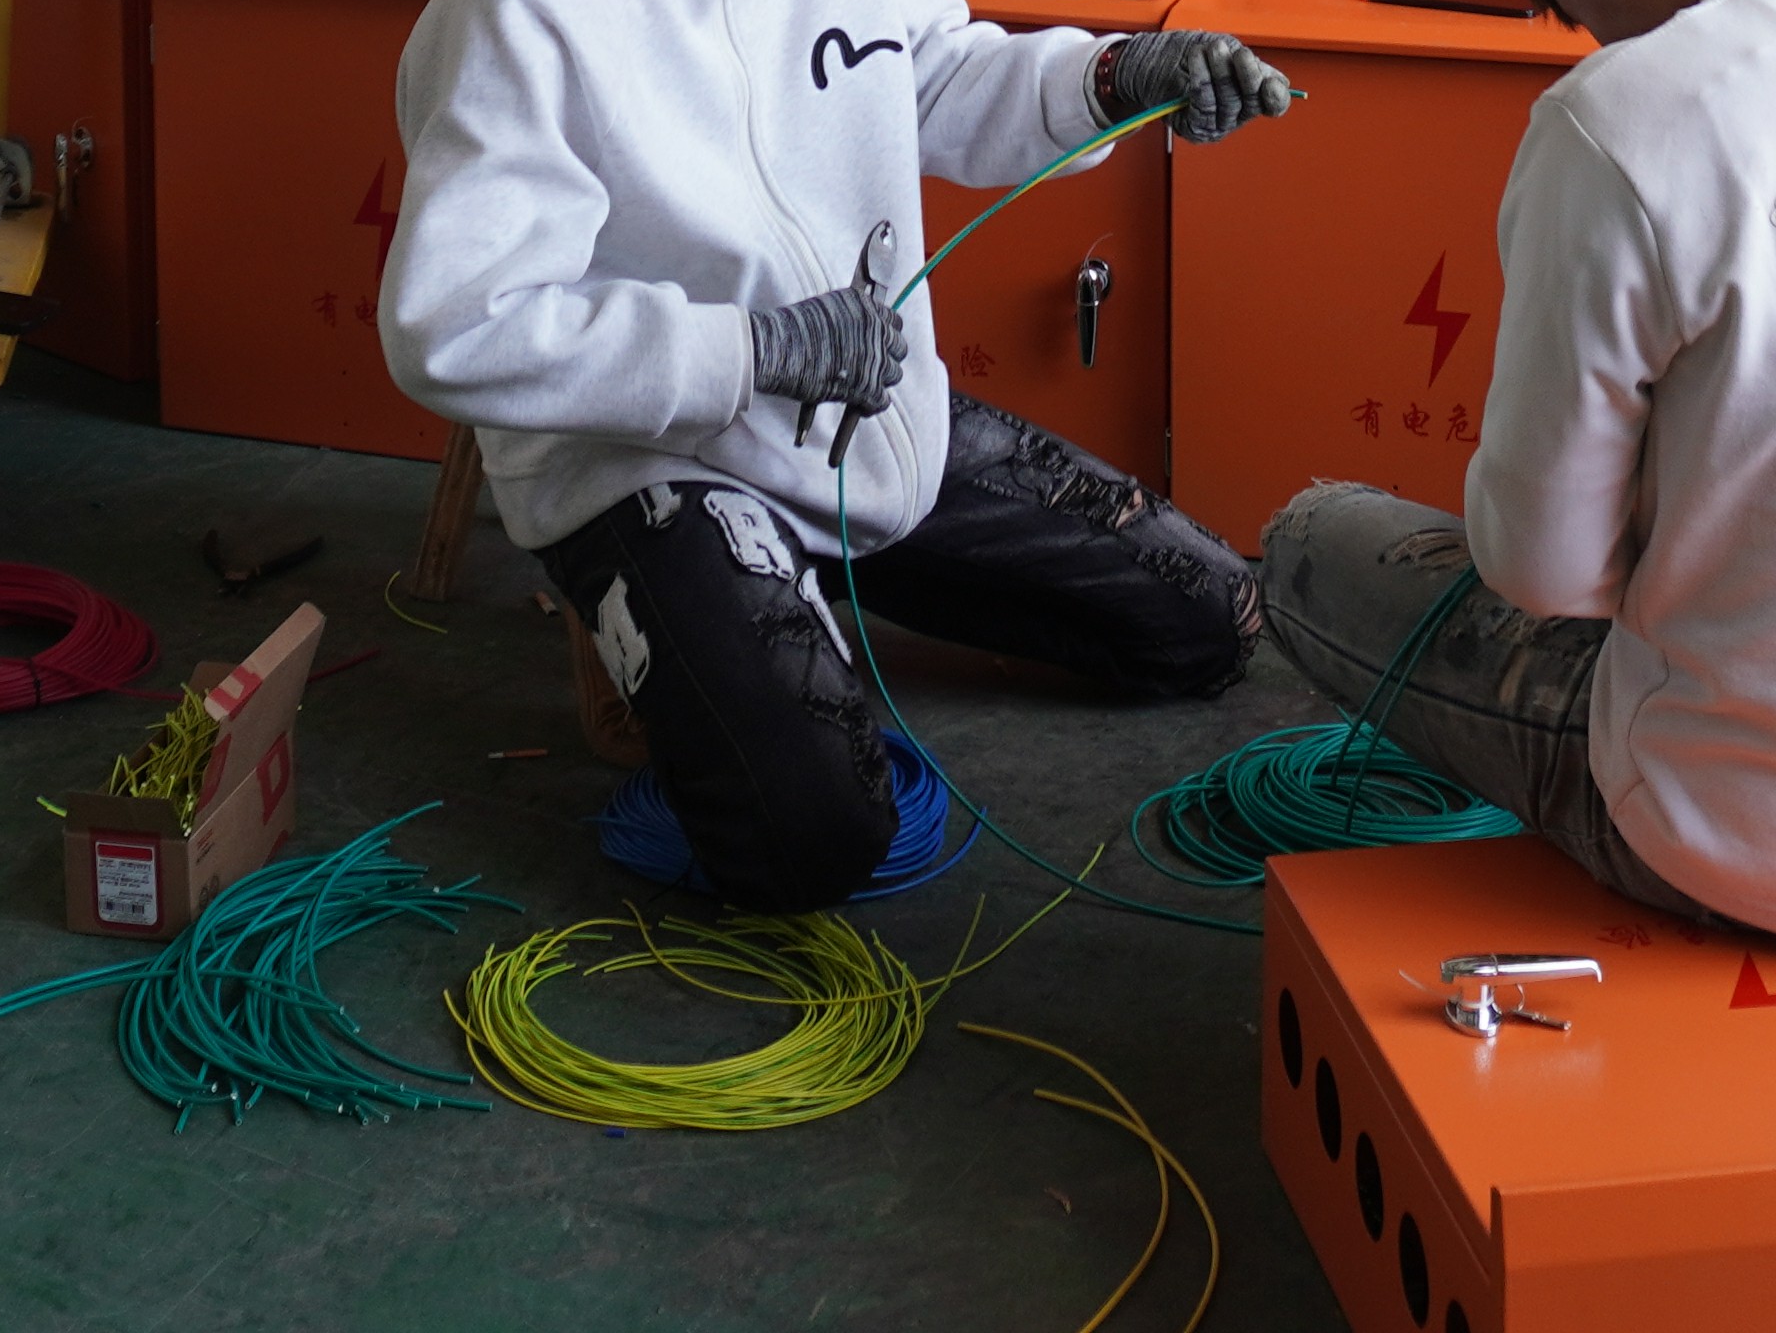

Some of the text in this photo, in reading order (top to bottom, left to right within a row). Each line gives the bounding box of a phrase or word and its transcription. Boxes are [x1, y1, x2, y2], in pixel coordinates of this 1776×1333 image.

[311, 291, 378, 328] 有电
[1349, 397, 1480, 444] 有电危
